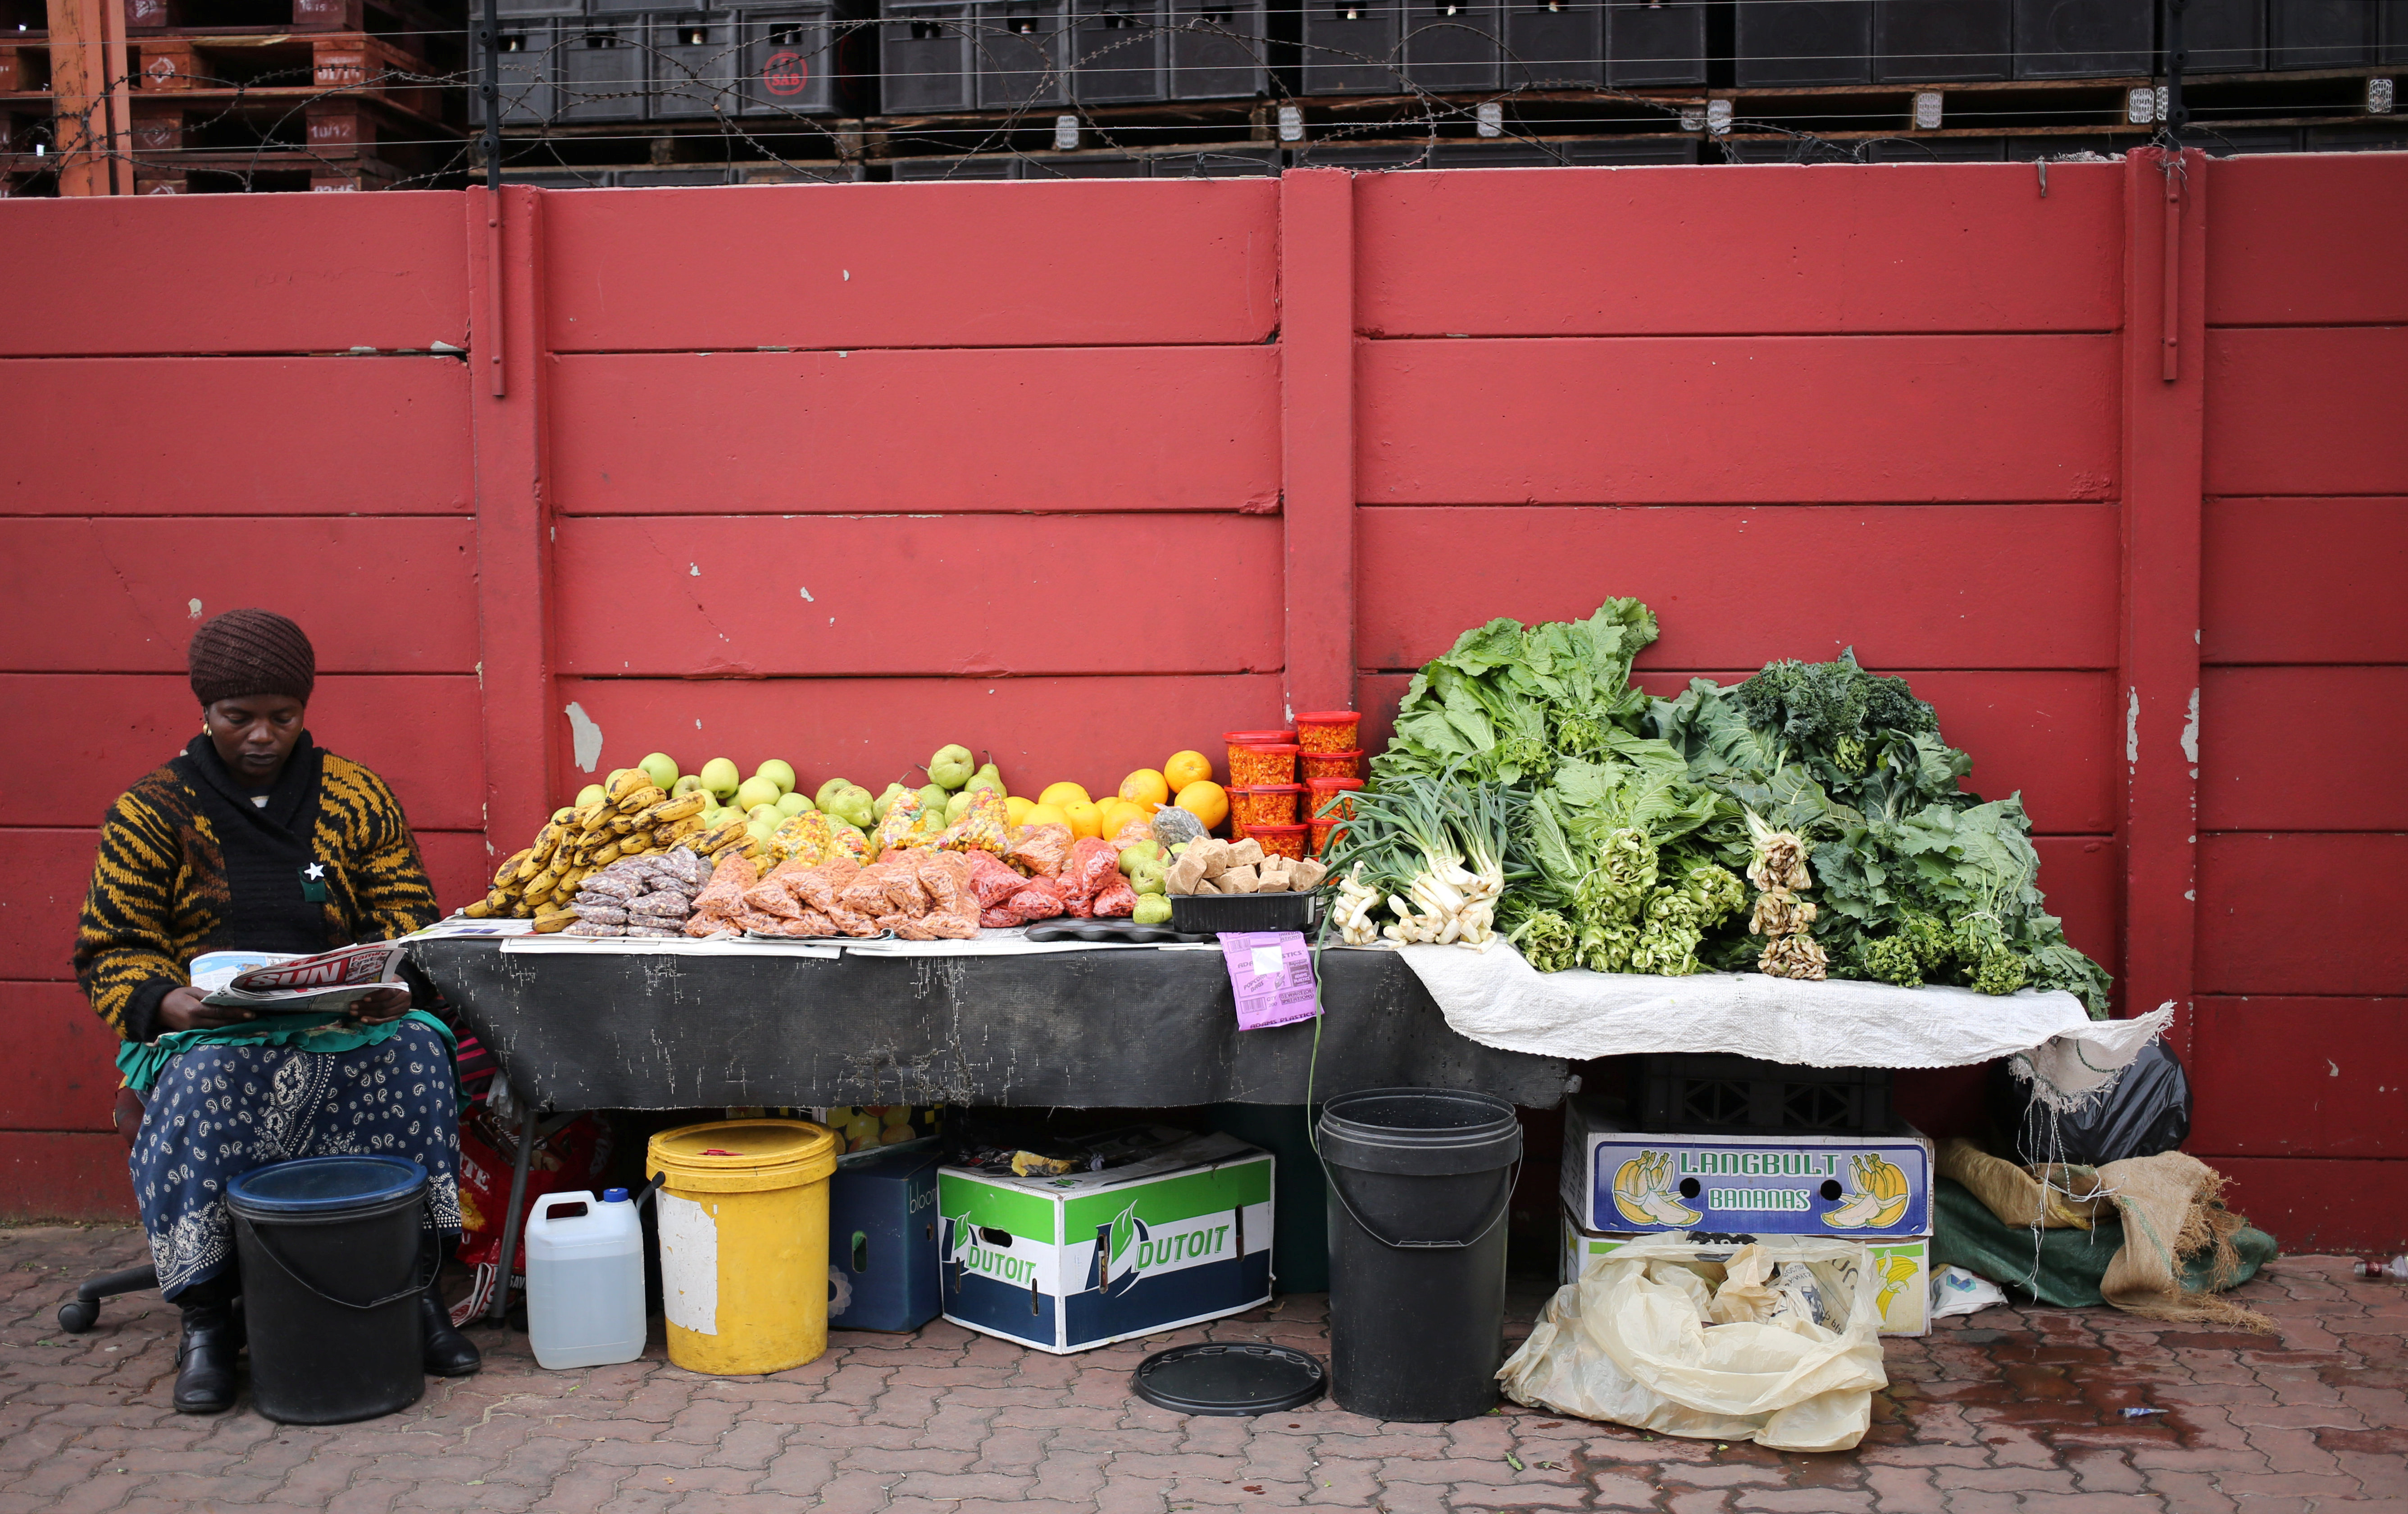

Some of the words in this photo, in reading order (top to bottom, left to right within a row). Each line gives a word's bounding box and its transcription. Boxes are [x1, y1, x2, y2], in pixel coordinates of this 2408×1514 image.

[772, 73, 800, 86] SAB
[352, 951, 387, 962] Family
[248, 962, 341, 987] SUN
[1251, 980, 1264, 992] BAGS
[1282, 994, 1313, 1004] IMITATIONS
[1250, 1020, 1277, 1029] ADAMS
[1280, 1012, 1315, 1023] PLASTICS
[1680, 1152, 1840, 1176] LANGBULT
[1709, 1188, 1810, 1210] BANANAS
[1135, 1224, 1230, 1271] DUTOIT
[966, 1245, 1036, 1285] DUTOIT
